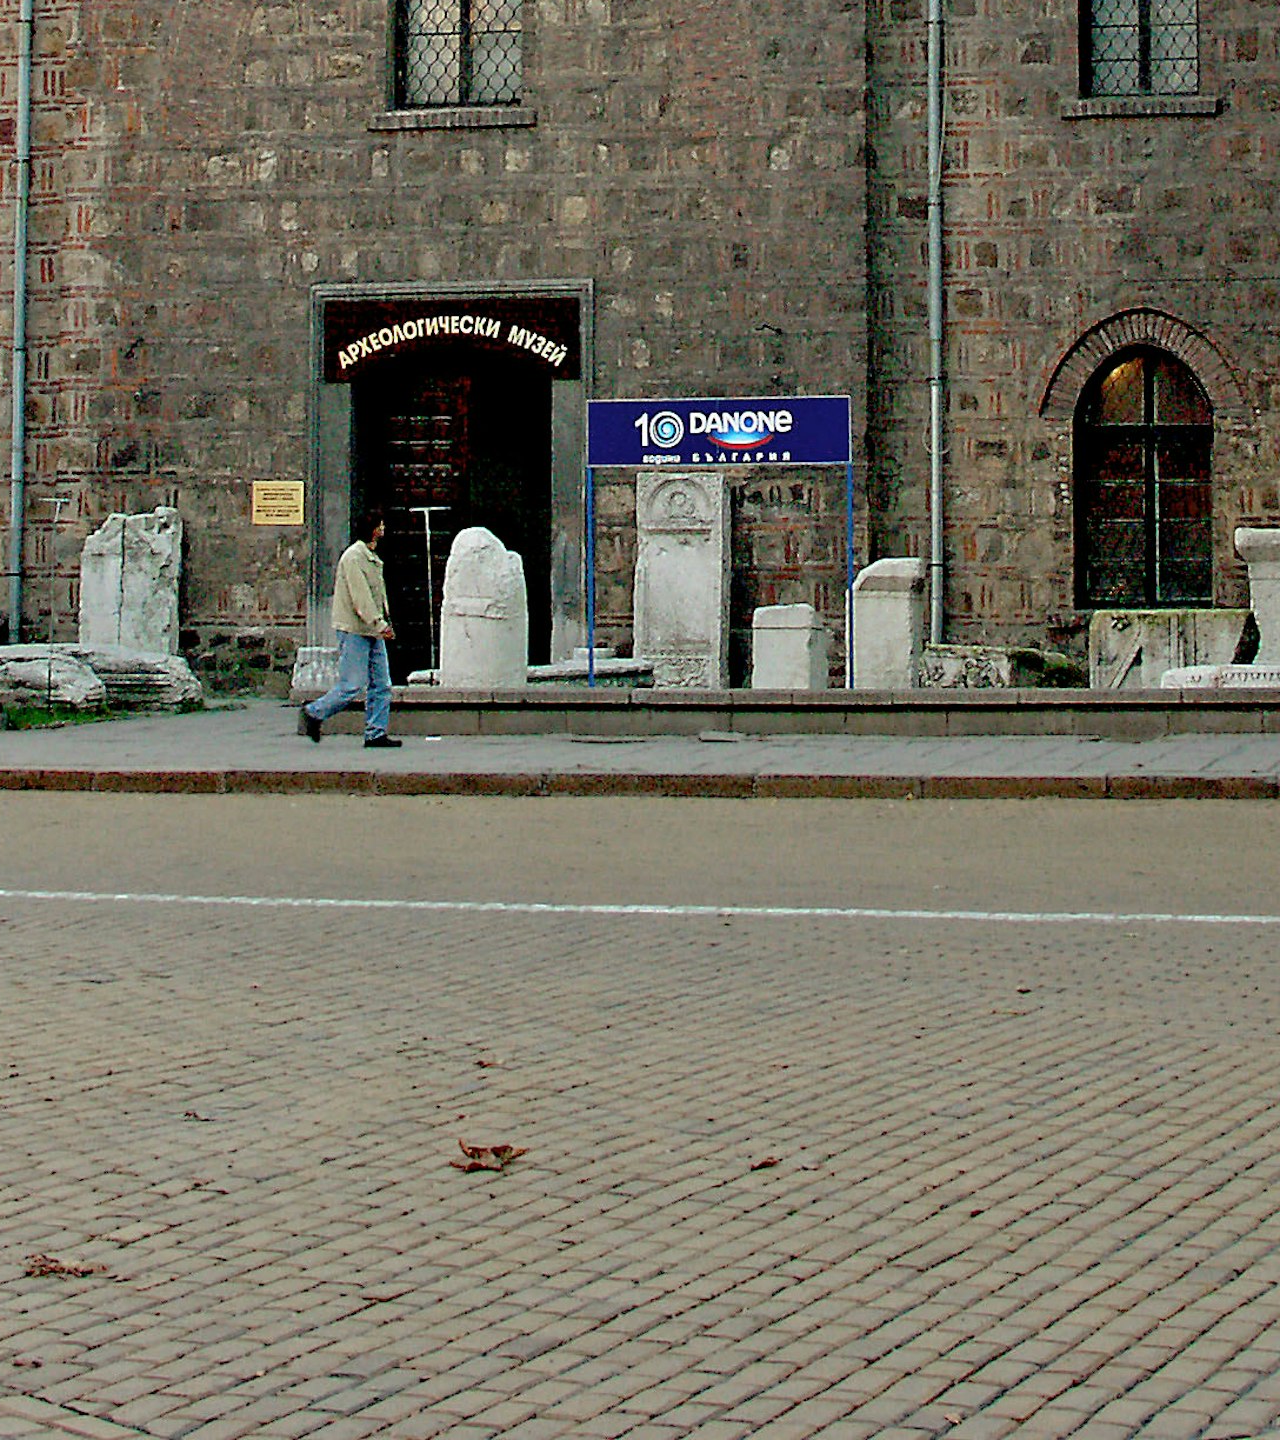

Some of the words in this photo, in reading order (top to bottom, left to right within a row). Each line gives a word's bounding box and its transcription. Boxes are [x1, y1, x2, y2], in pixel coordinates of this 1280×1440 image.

[338, 315, 501, 369] АРХЕОЛОГИЧЕСКИ
[507, 325, 568, 367] МУЗЕЙ
[635, 411, 684, 448] 10
[692, 452, 791, 462] БЪЛГАРИЯ
